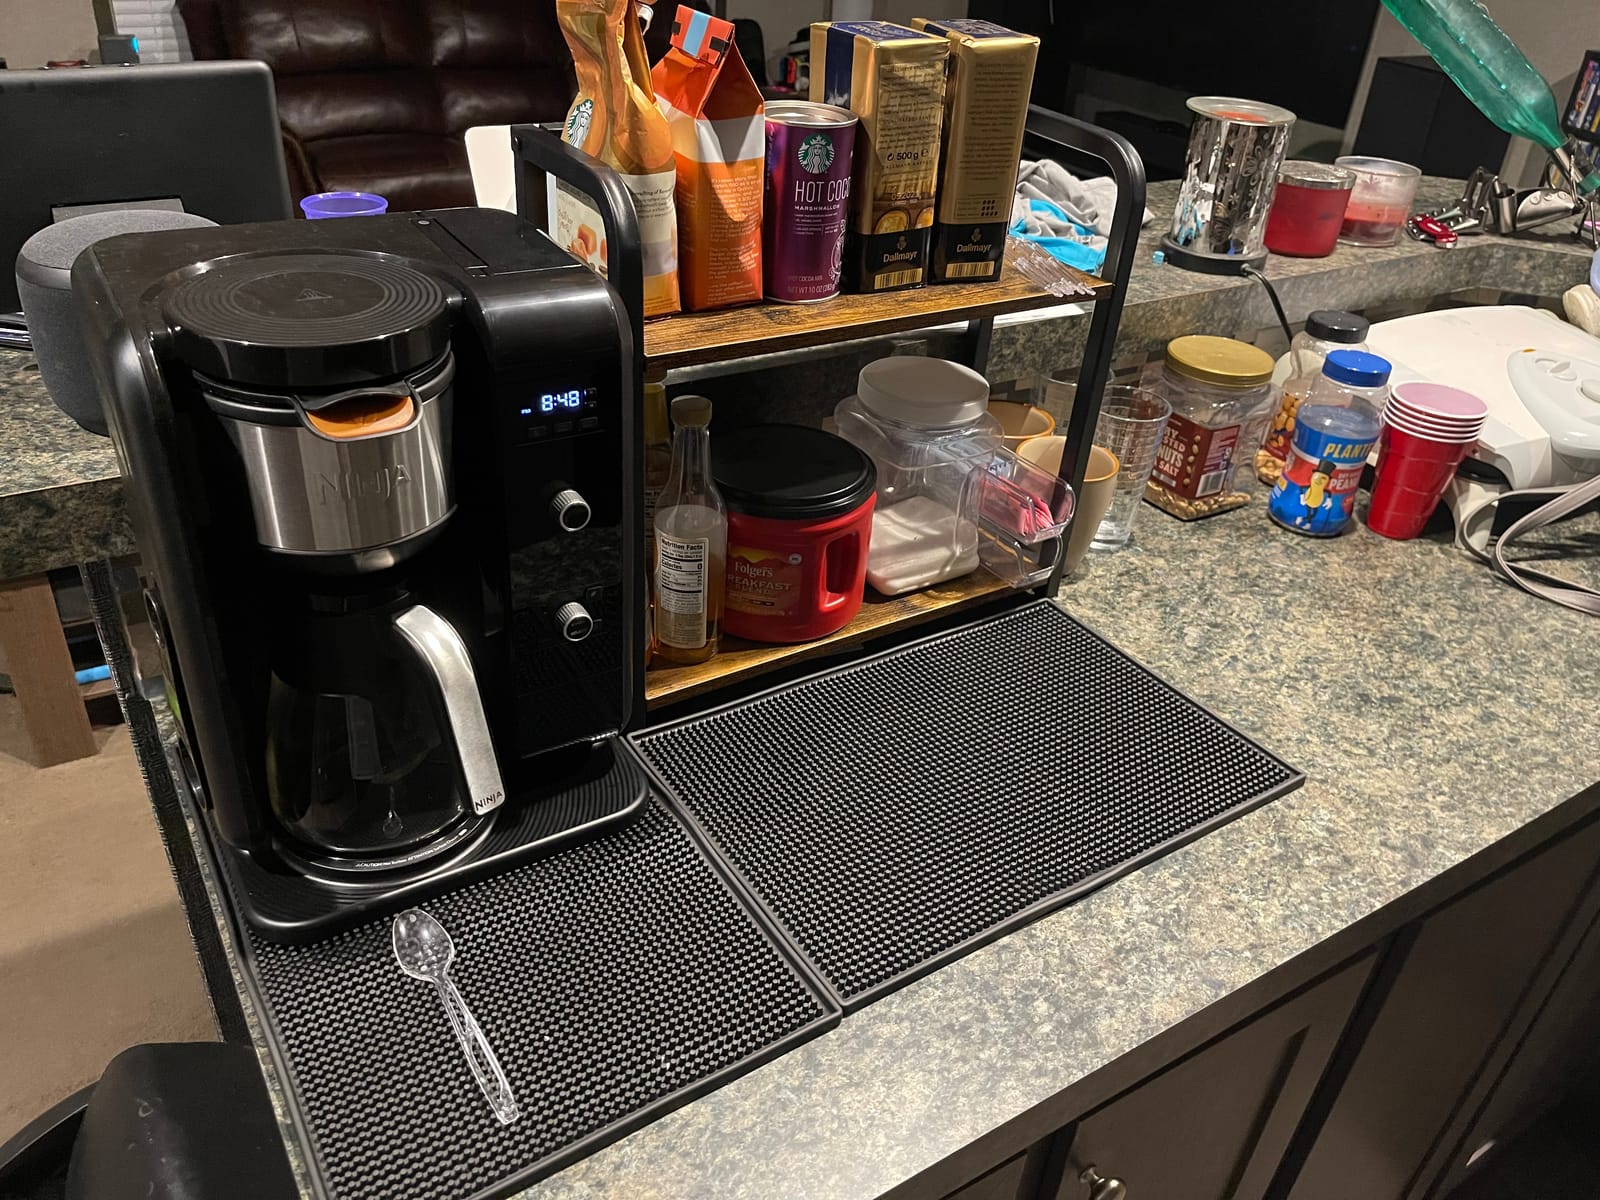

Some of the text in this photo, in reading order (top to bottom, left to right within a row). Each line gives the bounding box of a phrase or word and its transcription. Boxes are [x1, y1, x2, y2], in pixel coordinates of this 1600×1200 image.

[896, 152, 912, 160] 500
[795, 180, 824, 203] HOT
[883, 250, 918, 263] Dallmayr
[956, 243, 992, 254] Dallmayr
[541, 390, 580, 411] 8:48
[1162, 436, 1186, 452] STED
[1157, 444, 1184, 468] NUTS
[1158, 460, 1180, 476] SALT
[318, 464, 413, 506] NINJA
[661, 538, 685, 550] Nutrition
[661, 559, 703, 571] Calories 0
[735, 561, 774, 578] Folgers
[728, 574, 793, 592] REAKFAST
[475, 791, 503, 812] NINJA
